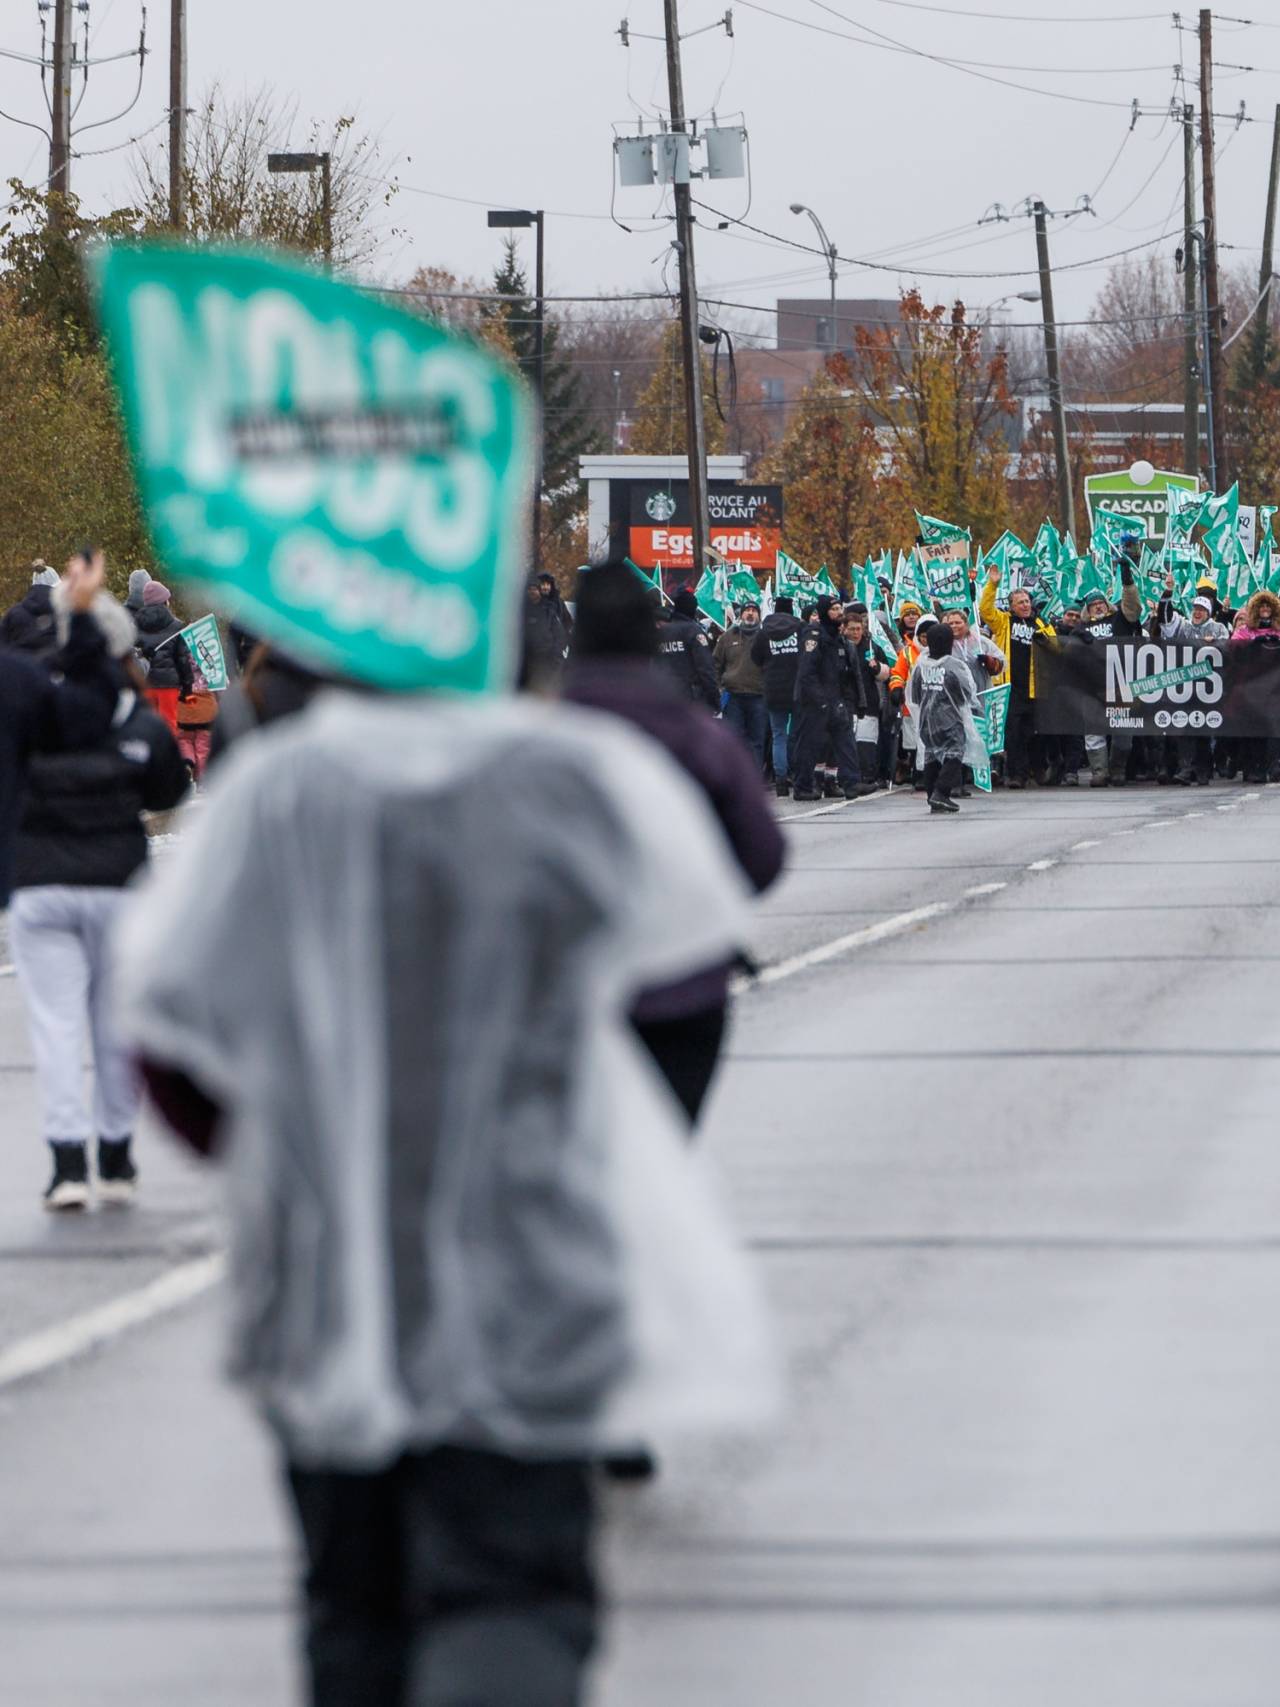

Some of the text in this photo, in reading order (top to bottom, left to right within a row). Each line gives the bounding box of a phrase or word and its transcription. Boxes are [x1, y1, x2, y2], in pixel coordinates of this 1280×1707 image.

[708, 496, 744, 506] RVICE
[1100, 500, 1169, 513] CASCAD
[708, 508, 756, 518] OLANT
[652, 530, 762, 555] Eggquis
[1106, 643, 1223, 703] NOUS
[1132, 663, 1209, 694] D'UNE SEULE VOIX
[1106, 707, 1131, 718] FRONT
[1109, 718, 1144, 728] COMMUN
